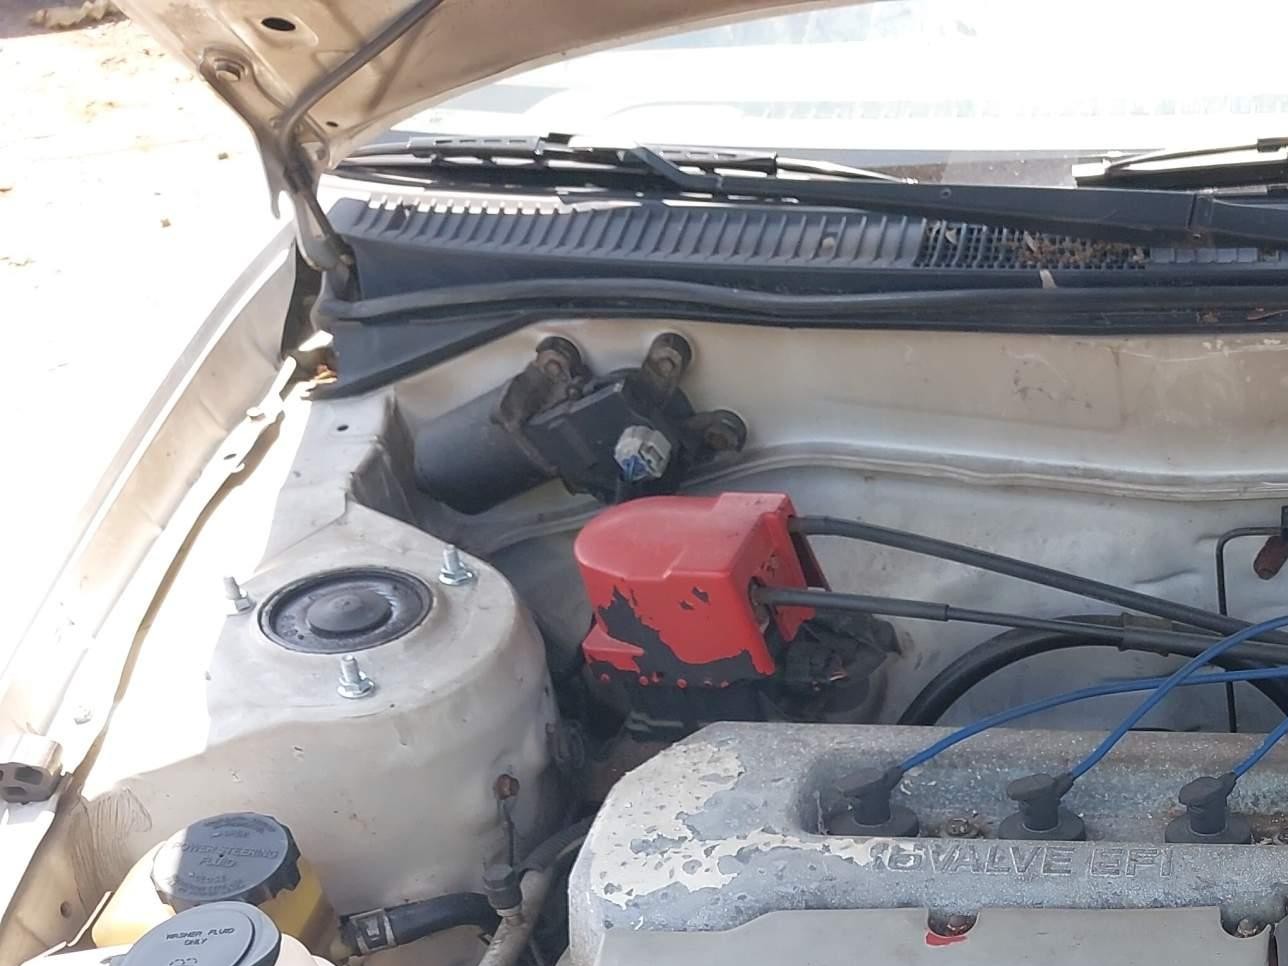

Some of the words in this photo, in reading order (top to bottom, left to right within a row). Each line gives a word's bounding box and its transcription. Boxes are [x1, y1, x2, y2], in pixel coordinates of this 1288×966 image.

[217, 846, 279, 859] STEERING
[200, 856, 238, 868] FLUID
[1090, 847, 1175, 878] EFI
[166, 931, 203, 940] WASHER
[207, 927, 235, 936] FLUID
[183, 938, 208, 946] ONLY
